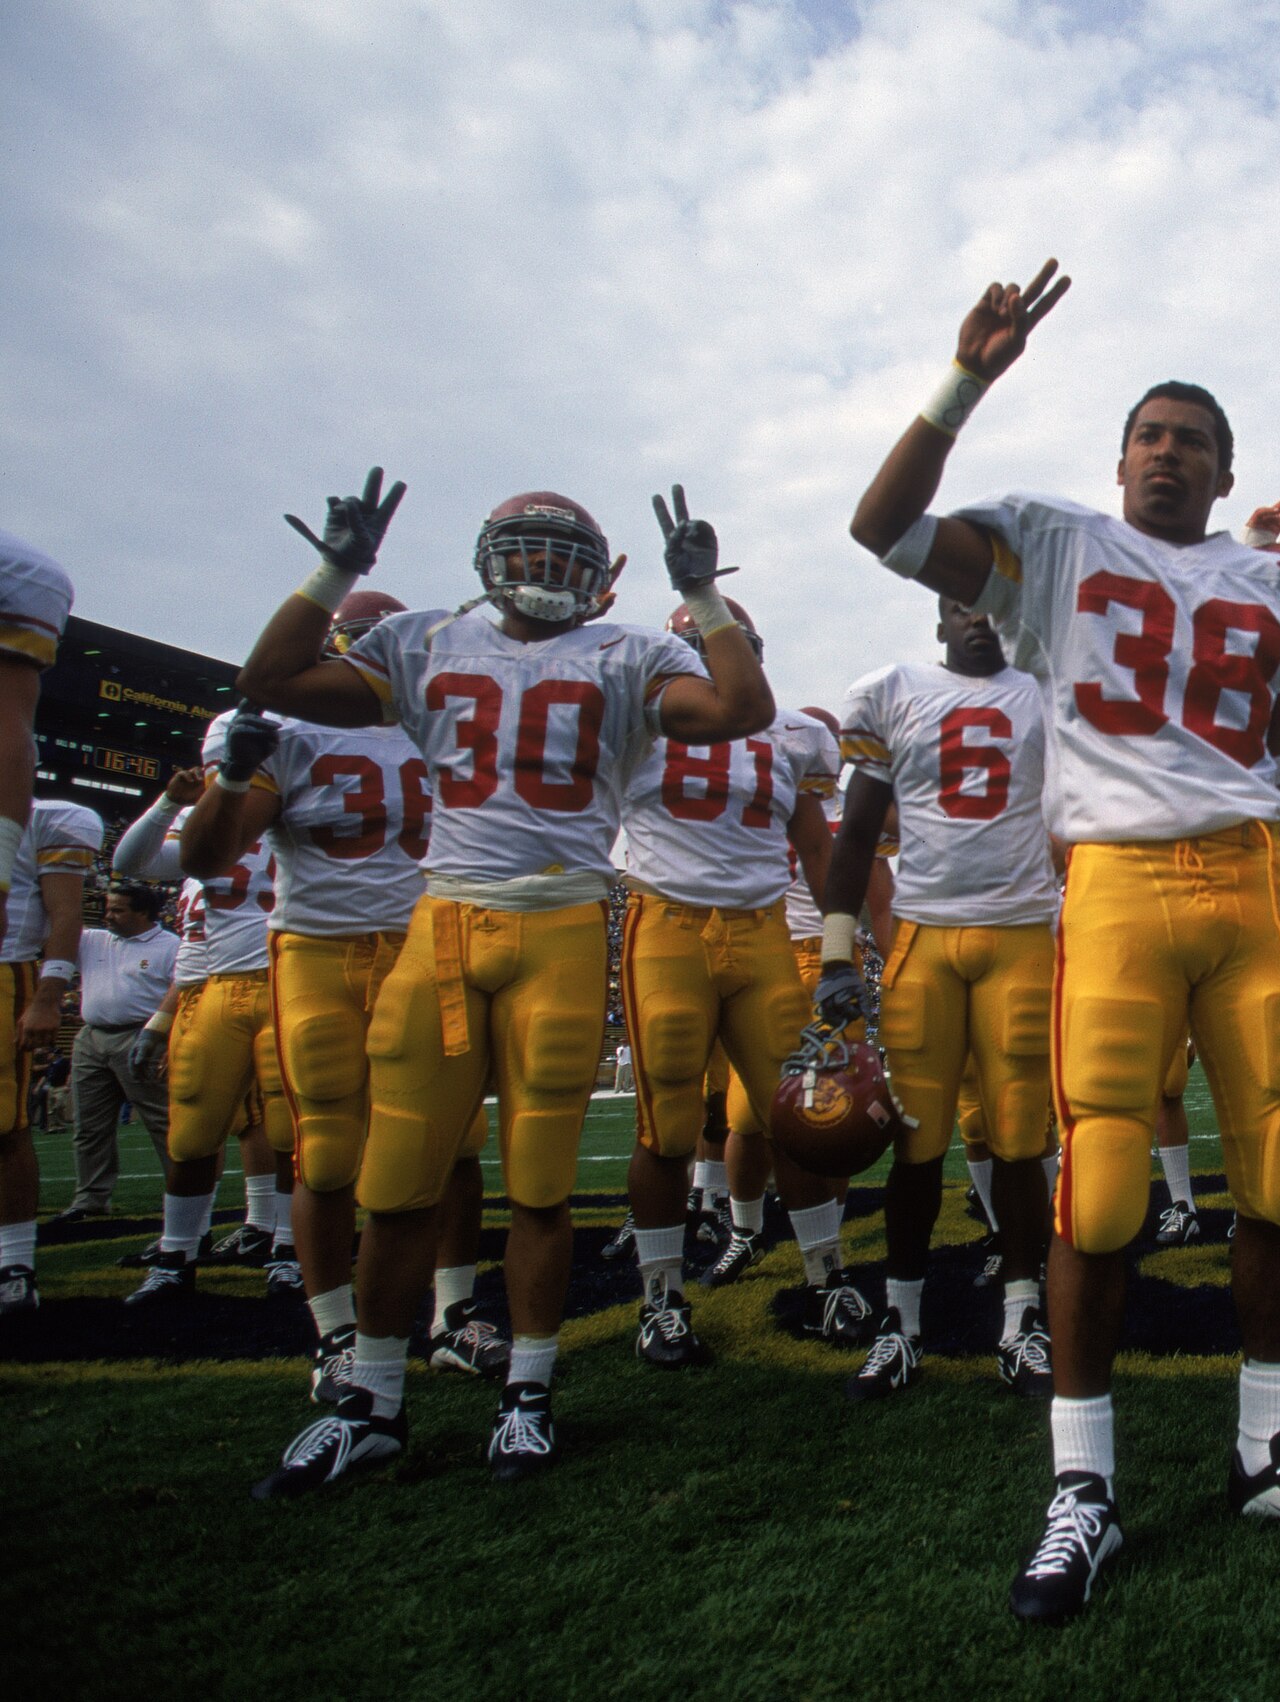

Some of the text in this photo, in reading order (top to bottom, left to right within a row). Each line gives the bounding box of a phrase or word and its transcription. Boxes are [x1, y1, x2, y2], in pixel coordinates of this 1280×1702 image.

[122, 687, 188, 713] California
[426, 671, 607, 813] 30
[104, 751, 156, 778] 16:46
[660, 737, 774, 830] 81
[937, 707, 1013, 820] 6
